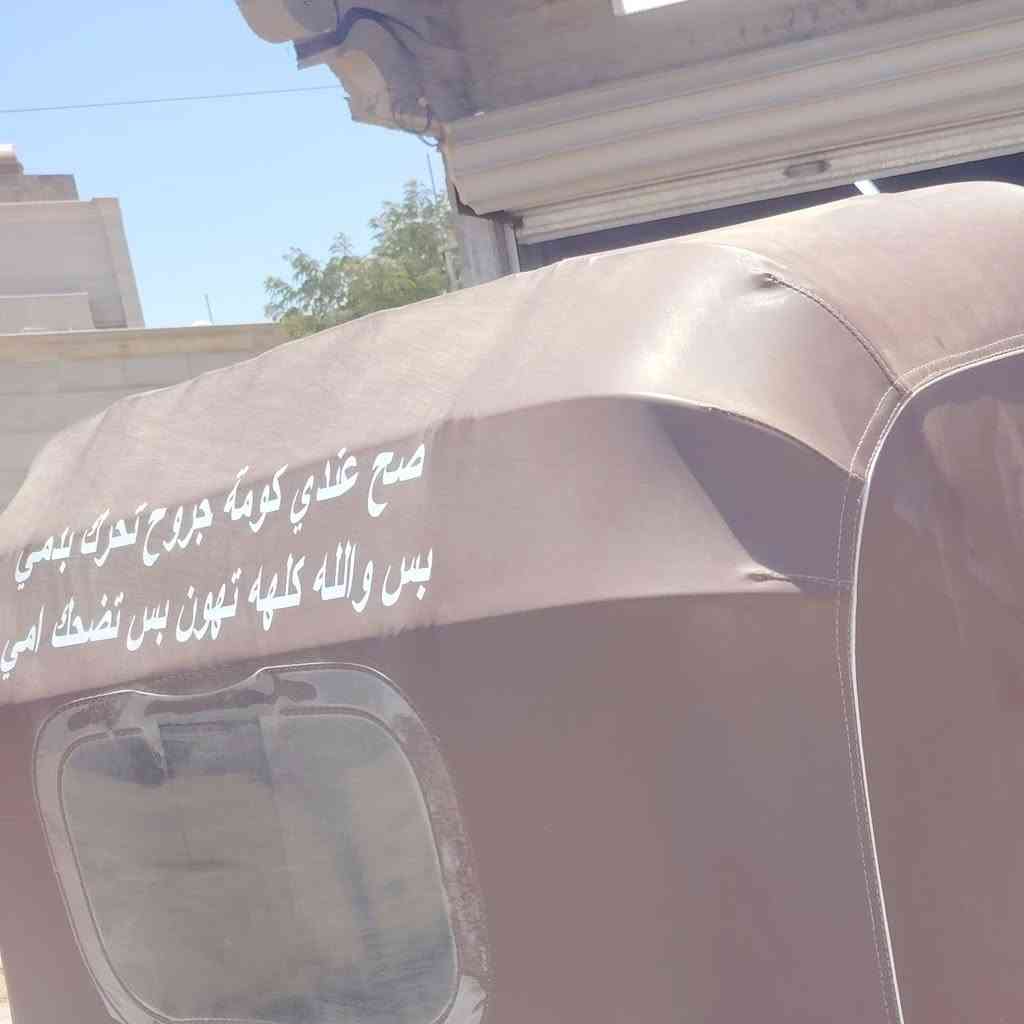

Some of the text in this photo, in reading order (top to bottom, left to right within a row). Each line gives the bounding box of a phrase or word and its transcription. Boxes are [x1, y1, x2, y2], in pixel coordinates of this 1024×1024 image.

[223, 464, 289, 533] كومة
[367, 443, 426, 518] صح
[80, 502, 149, 568] تحرك
[142, 498, 214, 567] جروح
[175, 566, 243, 642] تهون
[312, 538, 375, 613] والله
[381, 547, 433, 607] بس
[0, 604, 45, 681] امي
[51, 592, 125, 648] تضحك
[126, 599, 170, 652] بس
